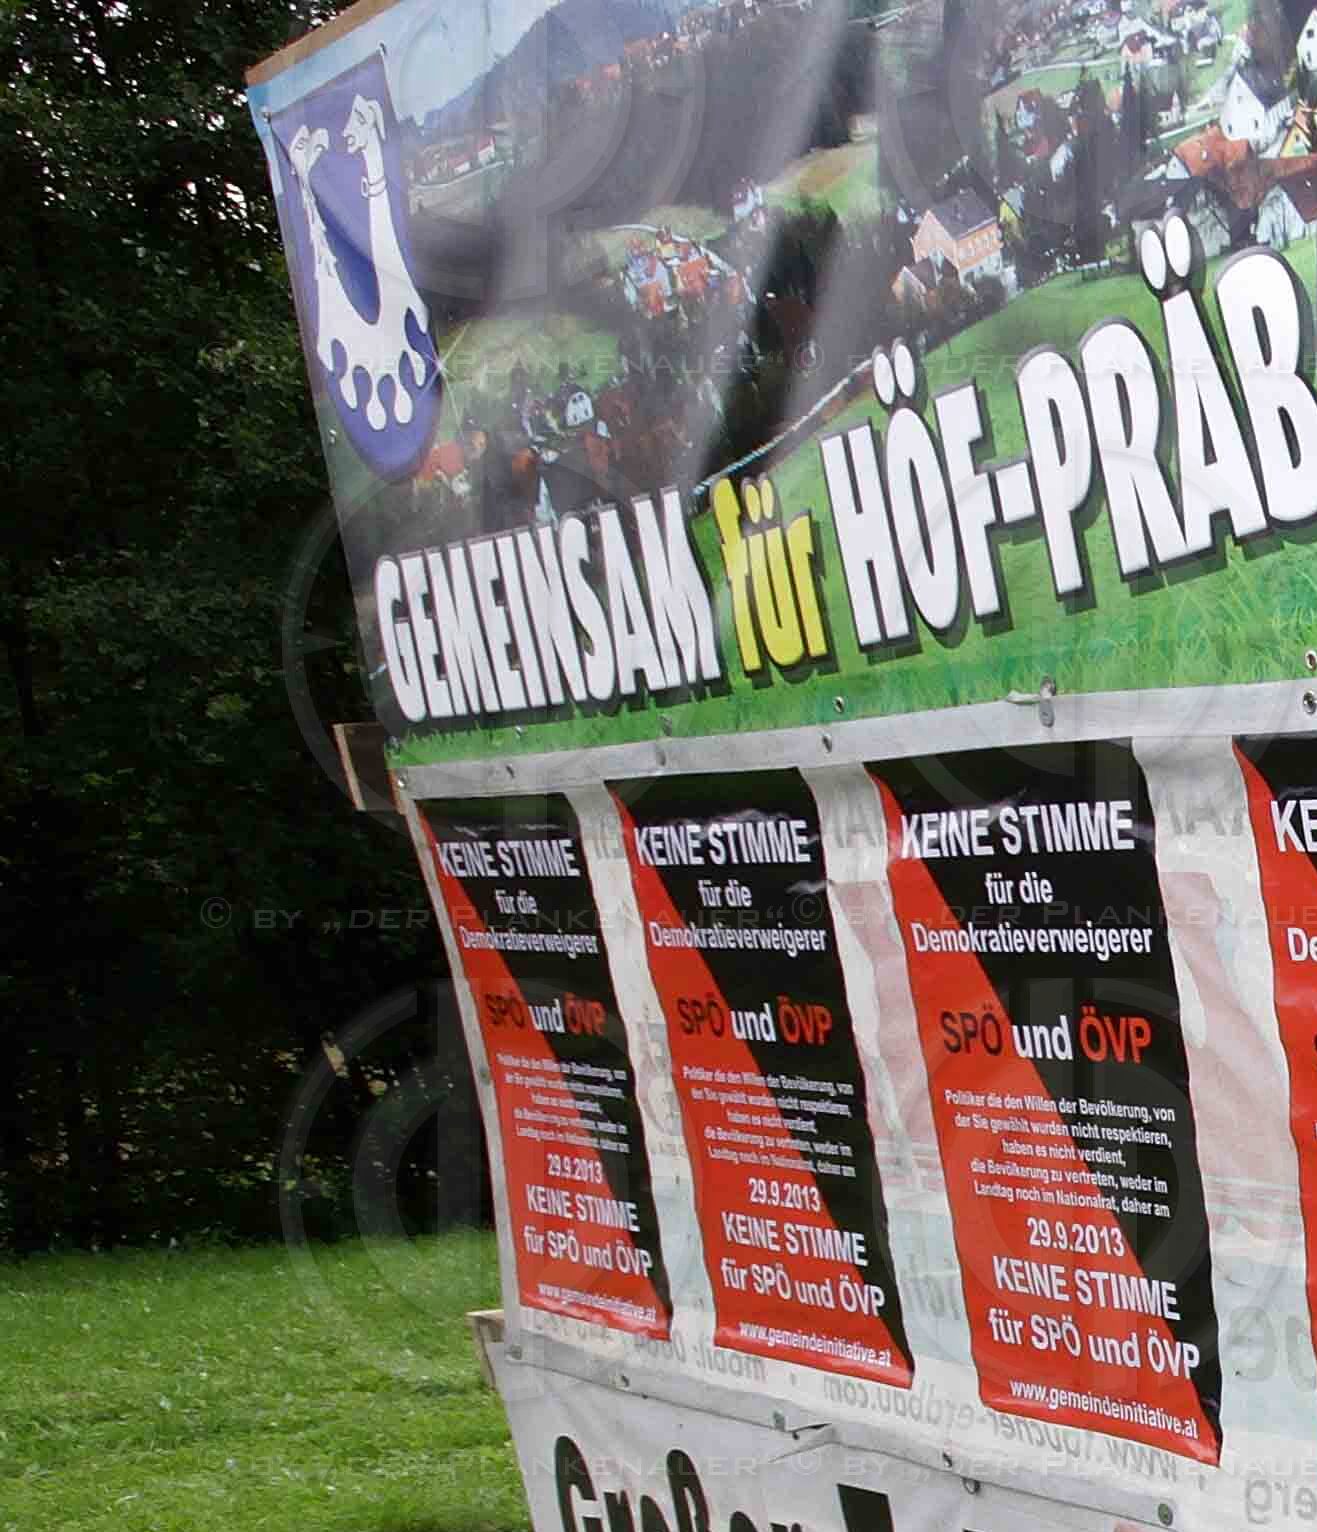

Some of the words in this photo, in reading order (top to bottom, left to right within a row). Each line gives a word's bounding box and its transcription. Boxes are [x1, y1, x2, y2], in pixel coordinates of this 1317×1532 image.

[375, 486, 721, 722] GEMEINSAM
[713, 477, 828, 670] für
[634, 824, 702, 866] KEINE
[708, 820, 811, 864] STIMME
[901, 809, 993, 858] KEINE
[1000, 801, 1135, 855] STIMME
[436, 842, 498, 878] KEINE
[500, 839, 580, 877] STIMME
[698, 880, 723, 907] für
[725, 880, 752, 907] die
[985, 873, 1013, 904] für
[1020, 872, 1053, 903] die
[650, 921, 827, 956] Demokratieverweigerer
[911, 920, 1153, 960] Demokratieverweigerer
[528, 1000, 565, 1033] und
[677, 994, 723, 1037] SPÖ
[731, 1003, 776, 1042] und
[777, 996, 832, 1045] ÖVP
[941, 1005, 1001, 1056] SPÖ
[1011, 1016, 1073, 1060] und
[1079, 1004, 1152, 1063] ÖVP
[749, 1178, 820, 1212] 29.9.2013
[721, 1212, 781, 1252] KEINE
[785, 1227, 867, 1266] STIMME
[1027, 1217, 1125, 1257] 29.9.2013
[721, 1259, 748, 1291] für
[752, 1266, 790, 1297] SPÖ
[795, 1278, 834, 1308] und
[839, 1276, 885, 1317] ÖVP
[992, 1256, 1070, 1301] KEINE
[1075, 1272, 1181, 1320] STIMME
[988, 1309, 1024, 1345] für
[1031, 1313, 1081, 1356] SPÖ
[1088, 1332, 1141, 1367] und
[1147, 1328, 1199, 1379] ÖVP
[1011, 1381, 1198, 1440] www.gemeindeinitiative.at
